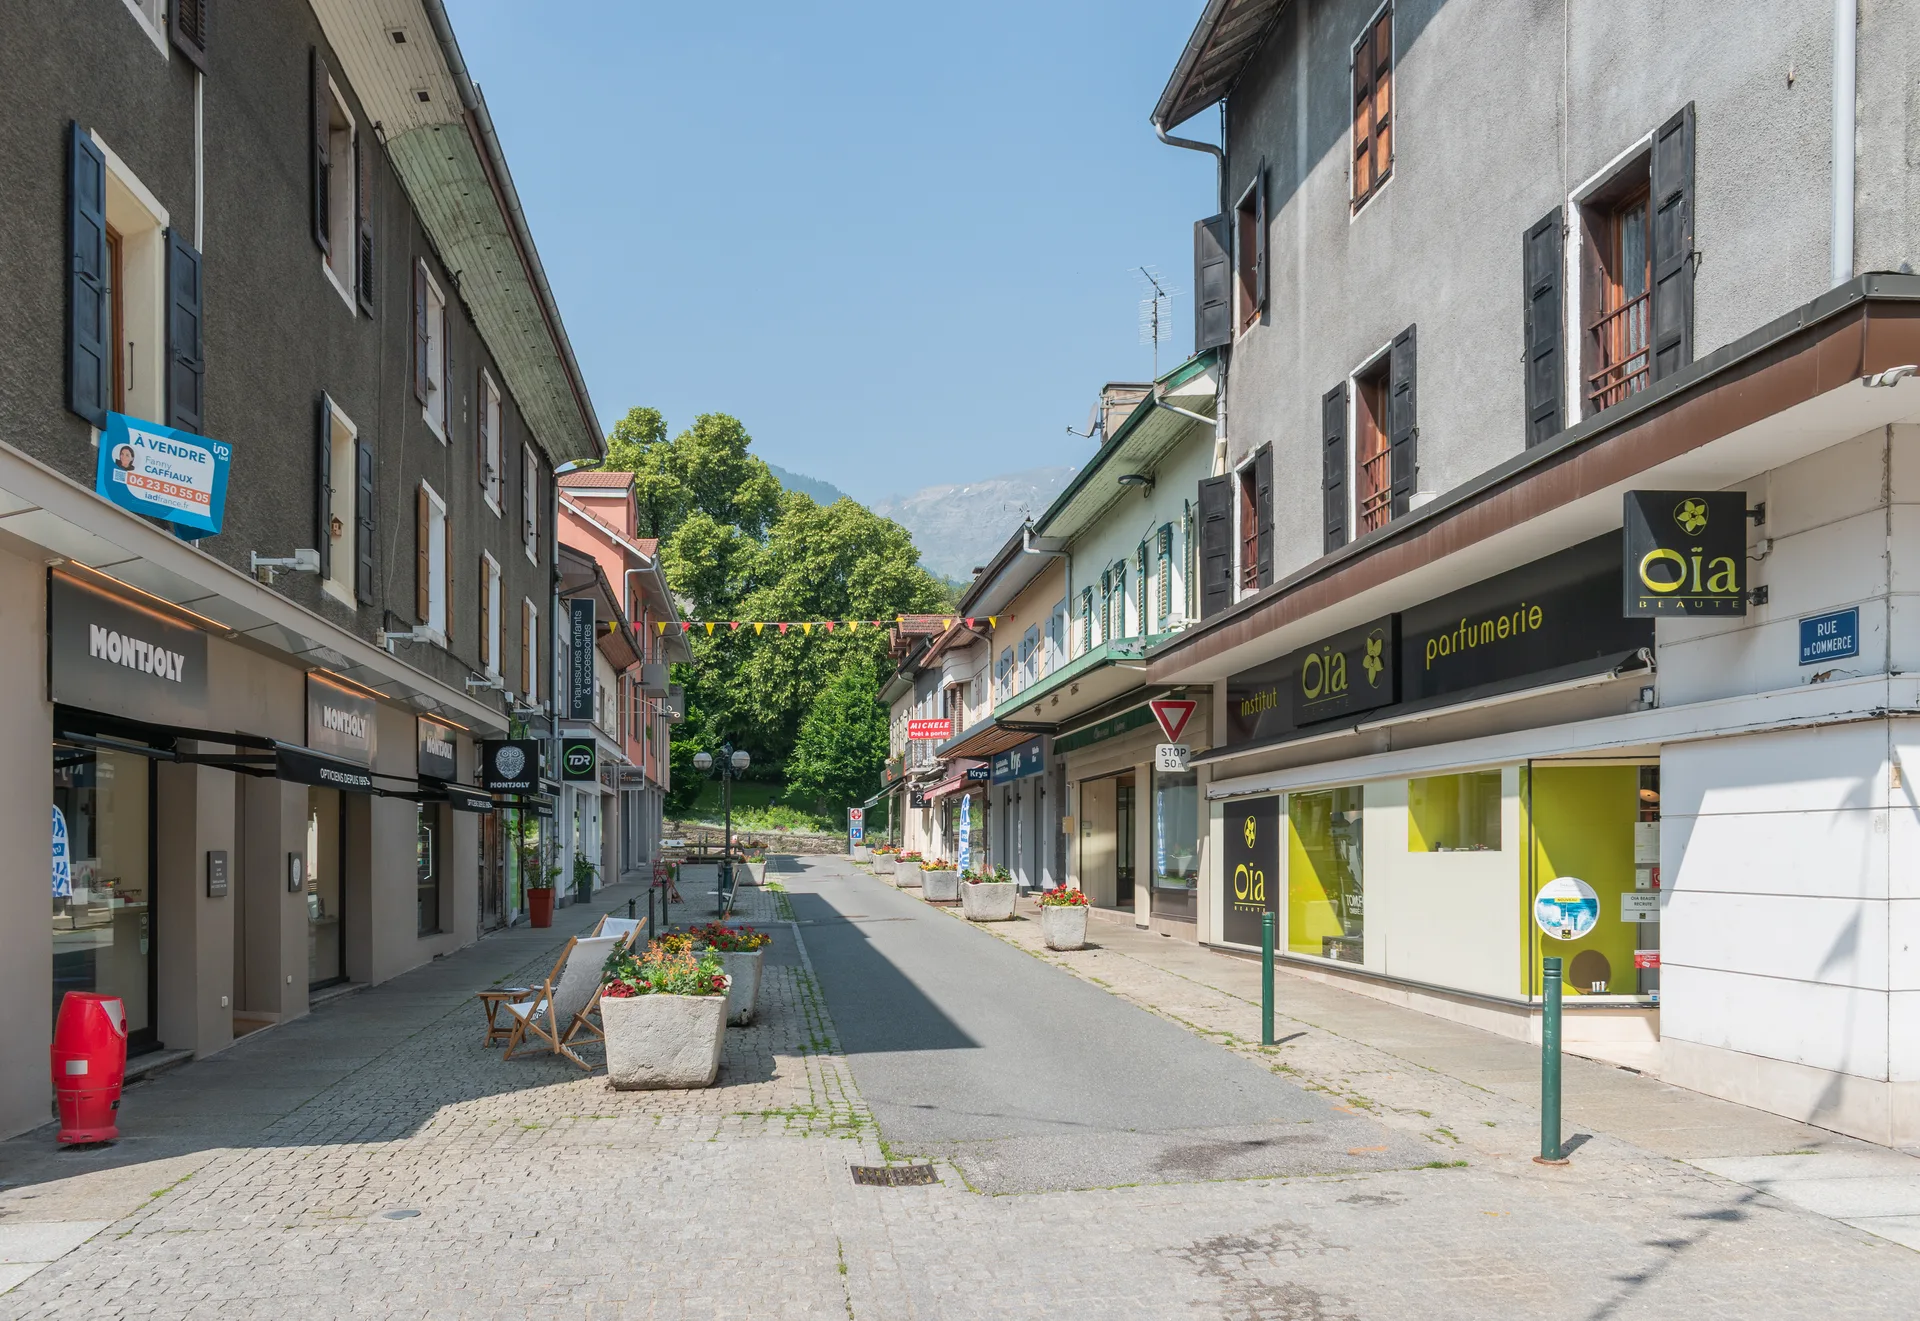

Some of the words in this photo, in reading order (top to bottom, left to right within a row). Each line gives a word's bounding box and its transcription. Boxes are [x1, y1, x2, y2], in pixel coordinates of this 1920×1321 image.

[134, 433, 145, 448] À
[149, 439, 206, 464] VENDRE
[145, 456, 172, 470] Fanny
[144, 466, 193, 484] CAFFIAUX
[129, 475, 144, 487] 06
[146, 479, 161, 491] 23
[163, 484, 177, 495] 50
[179, 487, 193, 499] 55
[195, 491, 209, 503] 05
[145, 492, 189, 509] iadfrance.fr
[1639, 546, 1741, 593] Oïa
[1639, 600, 1740, 609] BEAUTE
[573, 610, 582, 648] enfants
[1426, 602, 1543, 670] parfumerie
[1817, 620, 1838, 637] RUE
[89, 623, 185, 683] MONTJOLY
[582, 624, 591, 685] accessoires
[1803, 646, 1811, 657] DU
[1811, 635, 1852, 655] COMMERCE
[573, 650, 582, 709] chaussures
[1302, 645, 1349, 699] Oïa
[583, 687, 591, 695] &
[1241, 687, 1278, 717] institut
[323, 705, 366, 739] MONTJOLY
[910, 721, 950, 730] MICHELE
[568, 754, 591, 766] TDR
[1161, 747, 1187, 757] STOP
[1164, 759, 1177, 768] 50
[320, 767, 344, 783] OPTICIENS
[344, 773, 359, 785] DEPUIS
[970, 770, 988, 779] Krys
[490, 781, 530, 789] MONTJOLY
